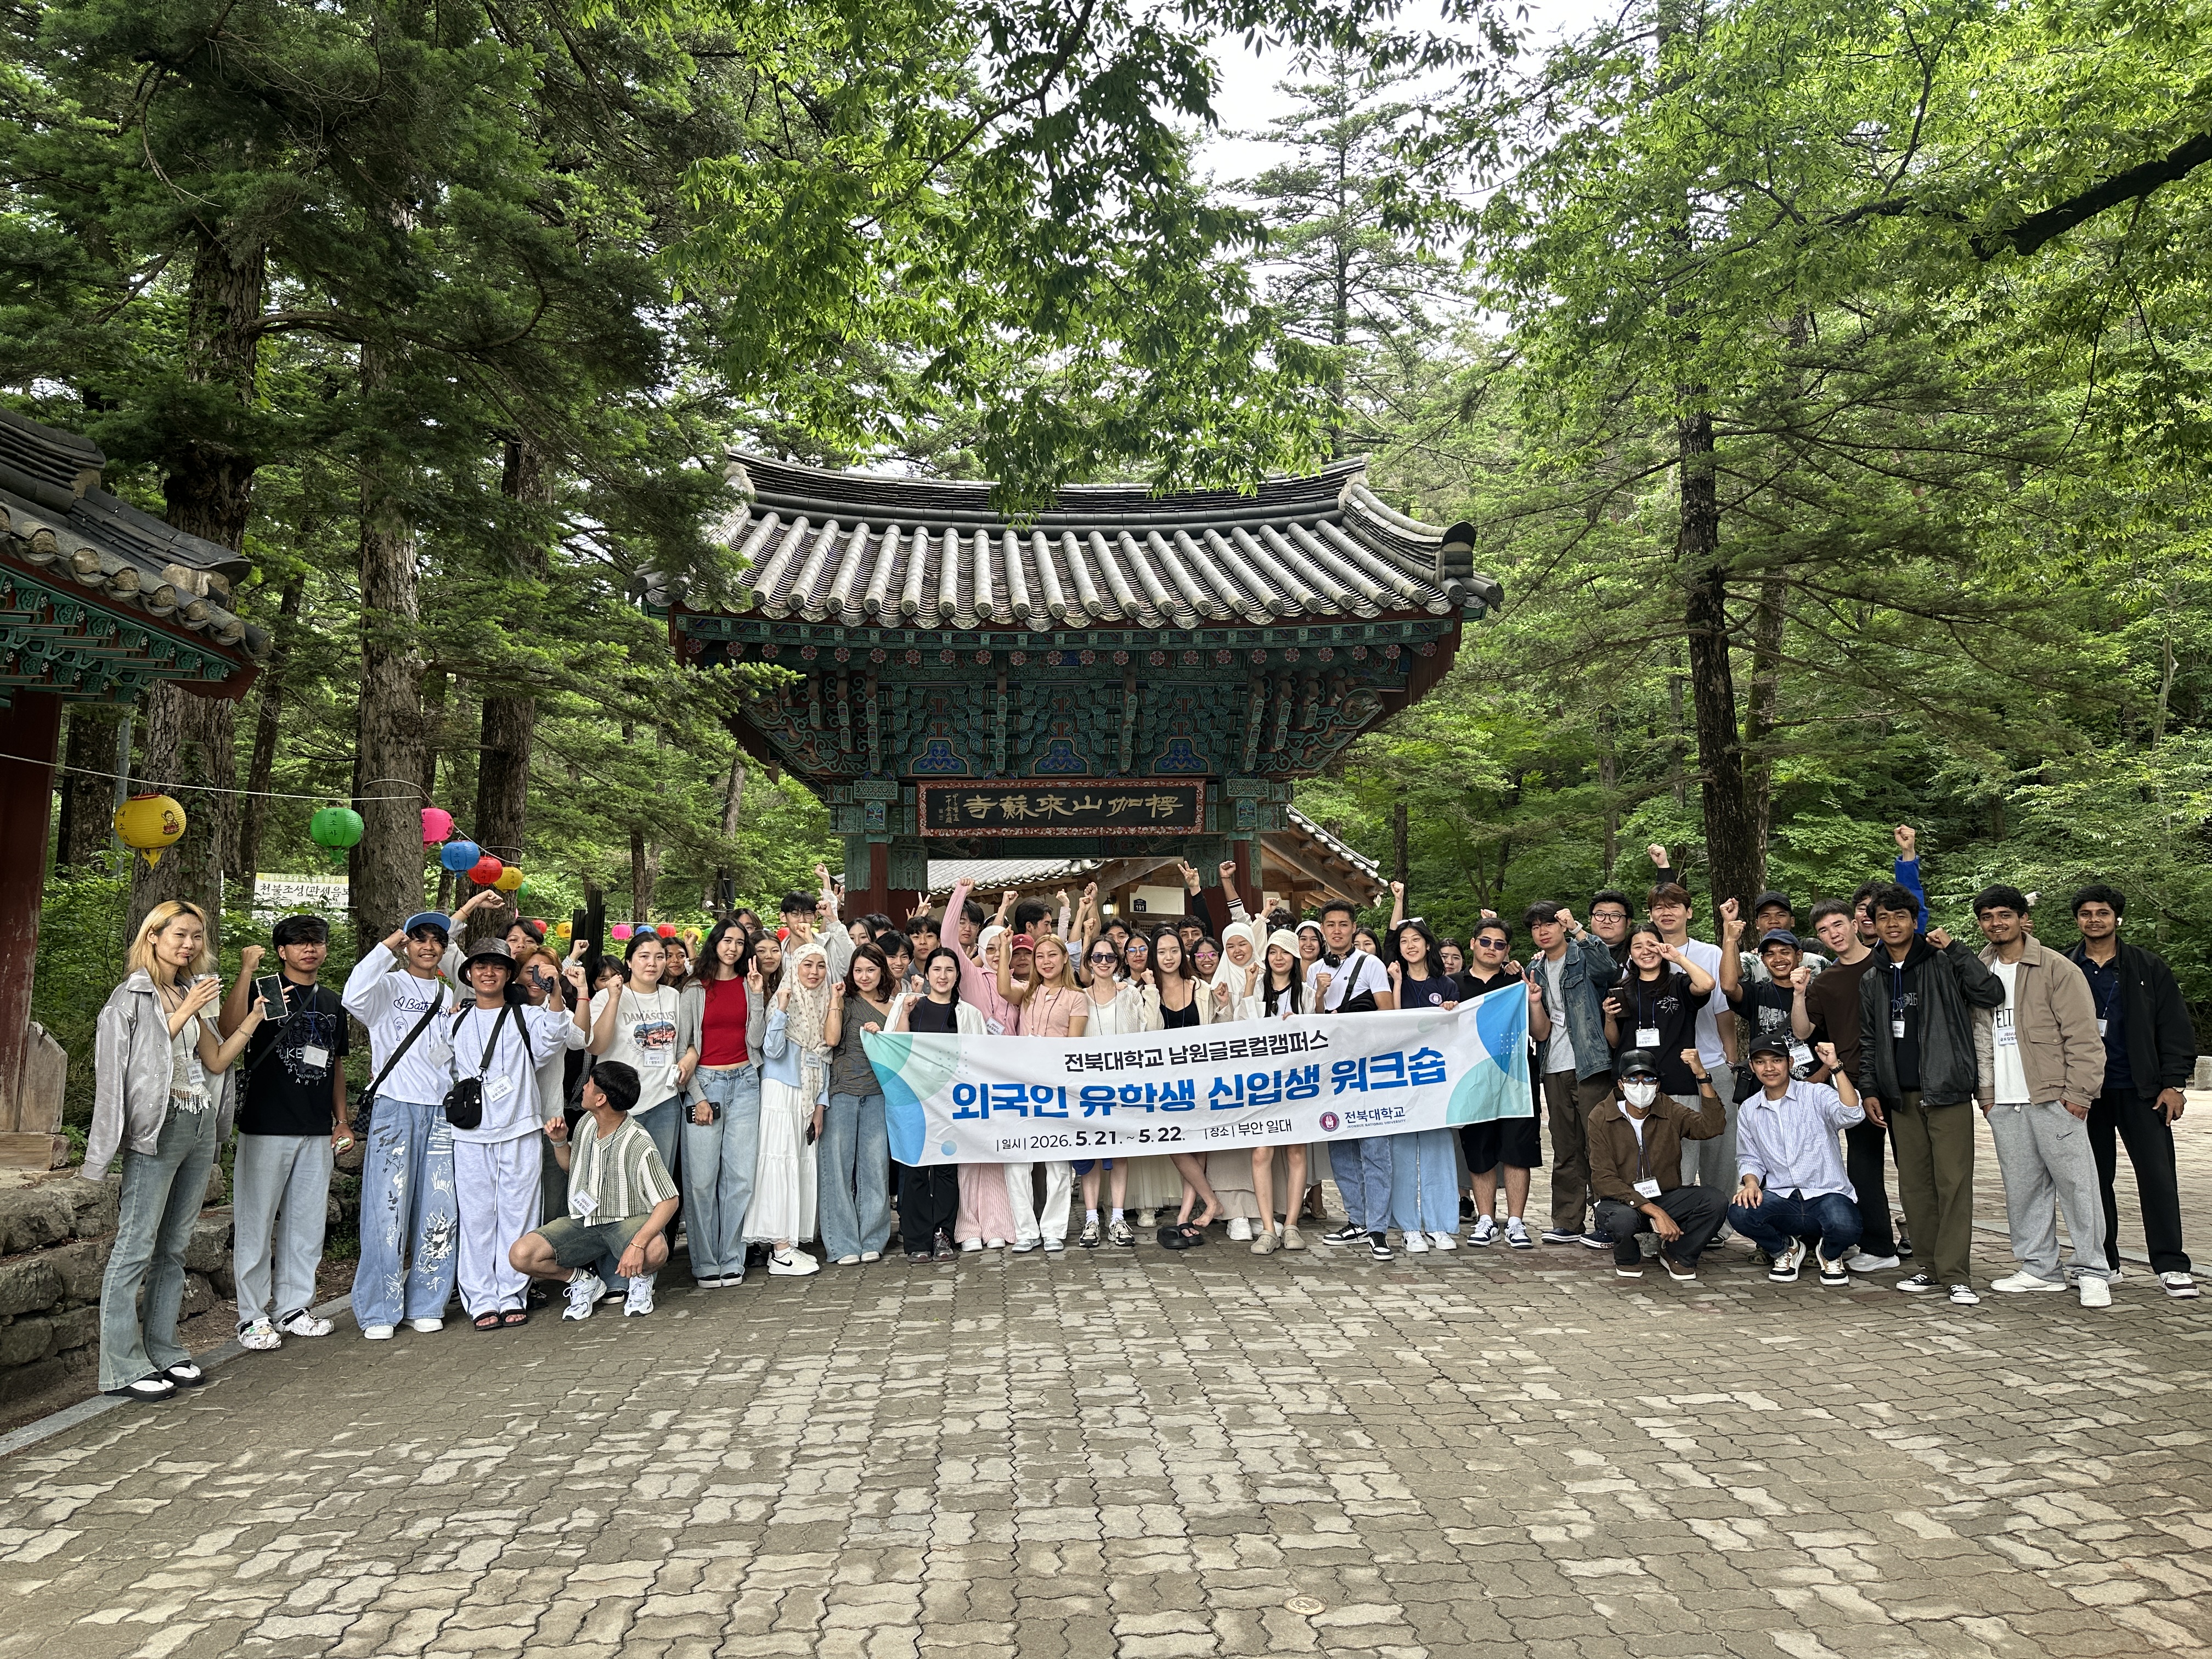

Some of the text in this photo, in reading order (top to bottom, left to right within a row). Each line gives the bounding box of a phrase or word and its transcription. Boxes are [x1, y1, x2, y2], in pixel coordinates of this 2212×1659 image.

[329, 811, 337, 836] 내소사
[1064, 1030, 1329, 1072] 전북대학교 남원글로컬캠퍼스
[952, 1046, 1447, 1120] 외국인 유학생 신입생 워크숍
[1344, 1107, 1406, 1124] 전북대학교
[1238, 1121, 1263, 1136] 부안
[1266, 1119, 1292, 1133] 일대
[1030, 1135, 1072, 1149] 2026.
